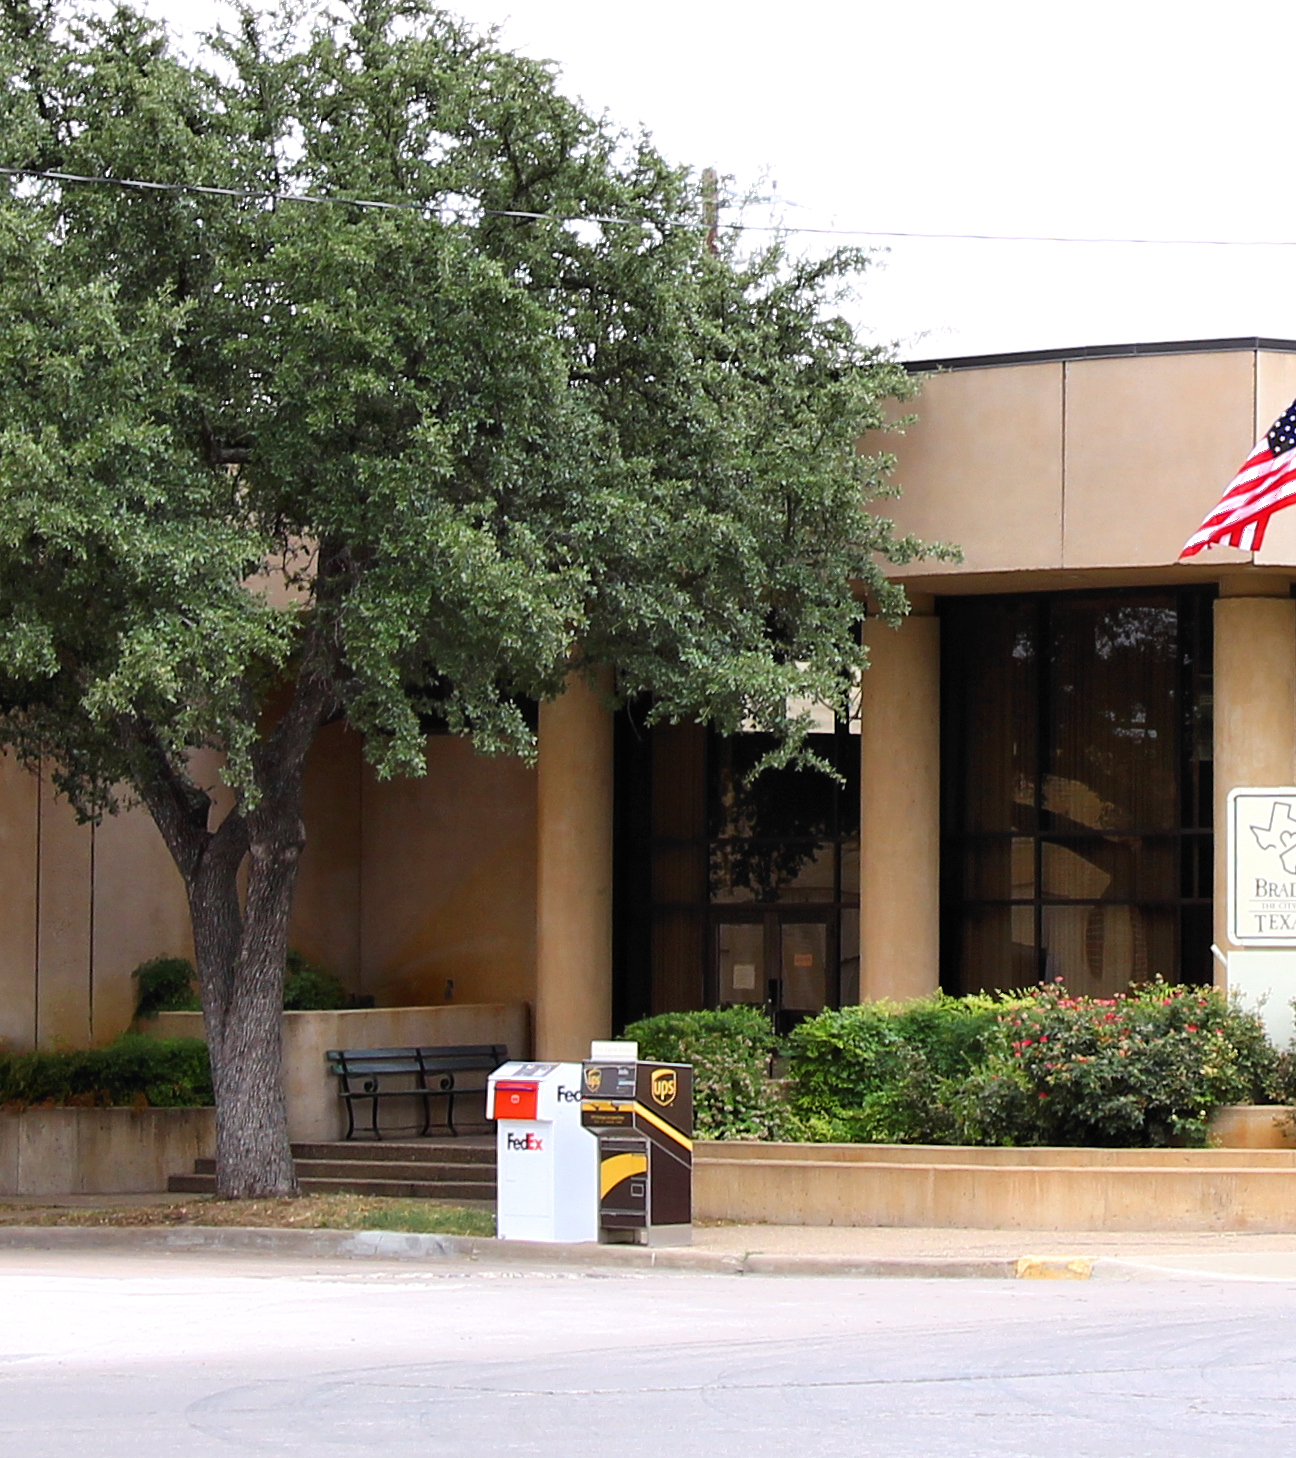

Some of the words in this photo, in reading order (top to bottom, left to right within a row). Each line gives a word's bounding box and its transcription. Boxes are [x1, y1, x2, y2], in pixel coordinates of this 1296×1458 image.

[1261, 902, 1276, 910] THE
[1278, 902, 1296, 910] CITY
[507, 1132, 543, 1151] FedEx
